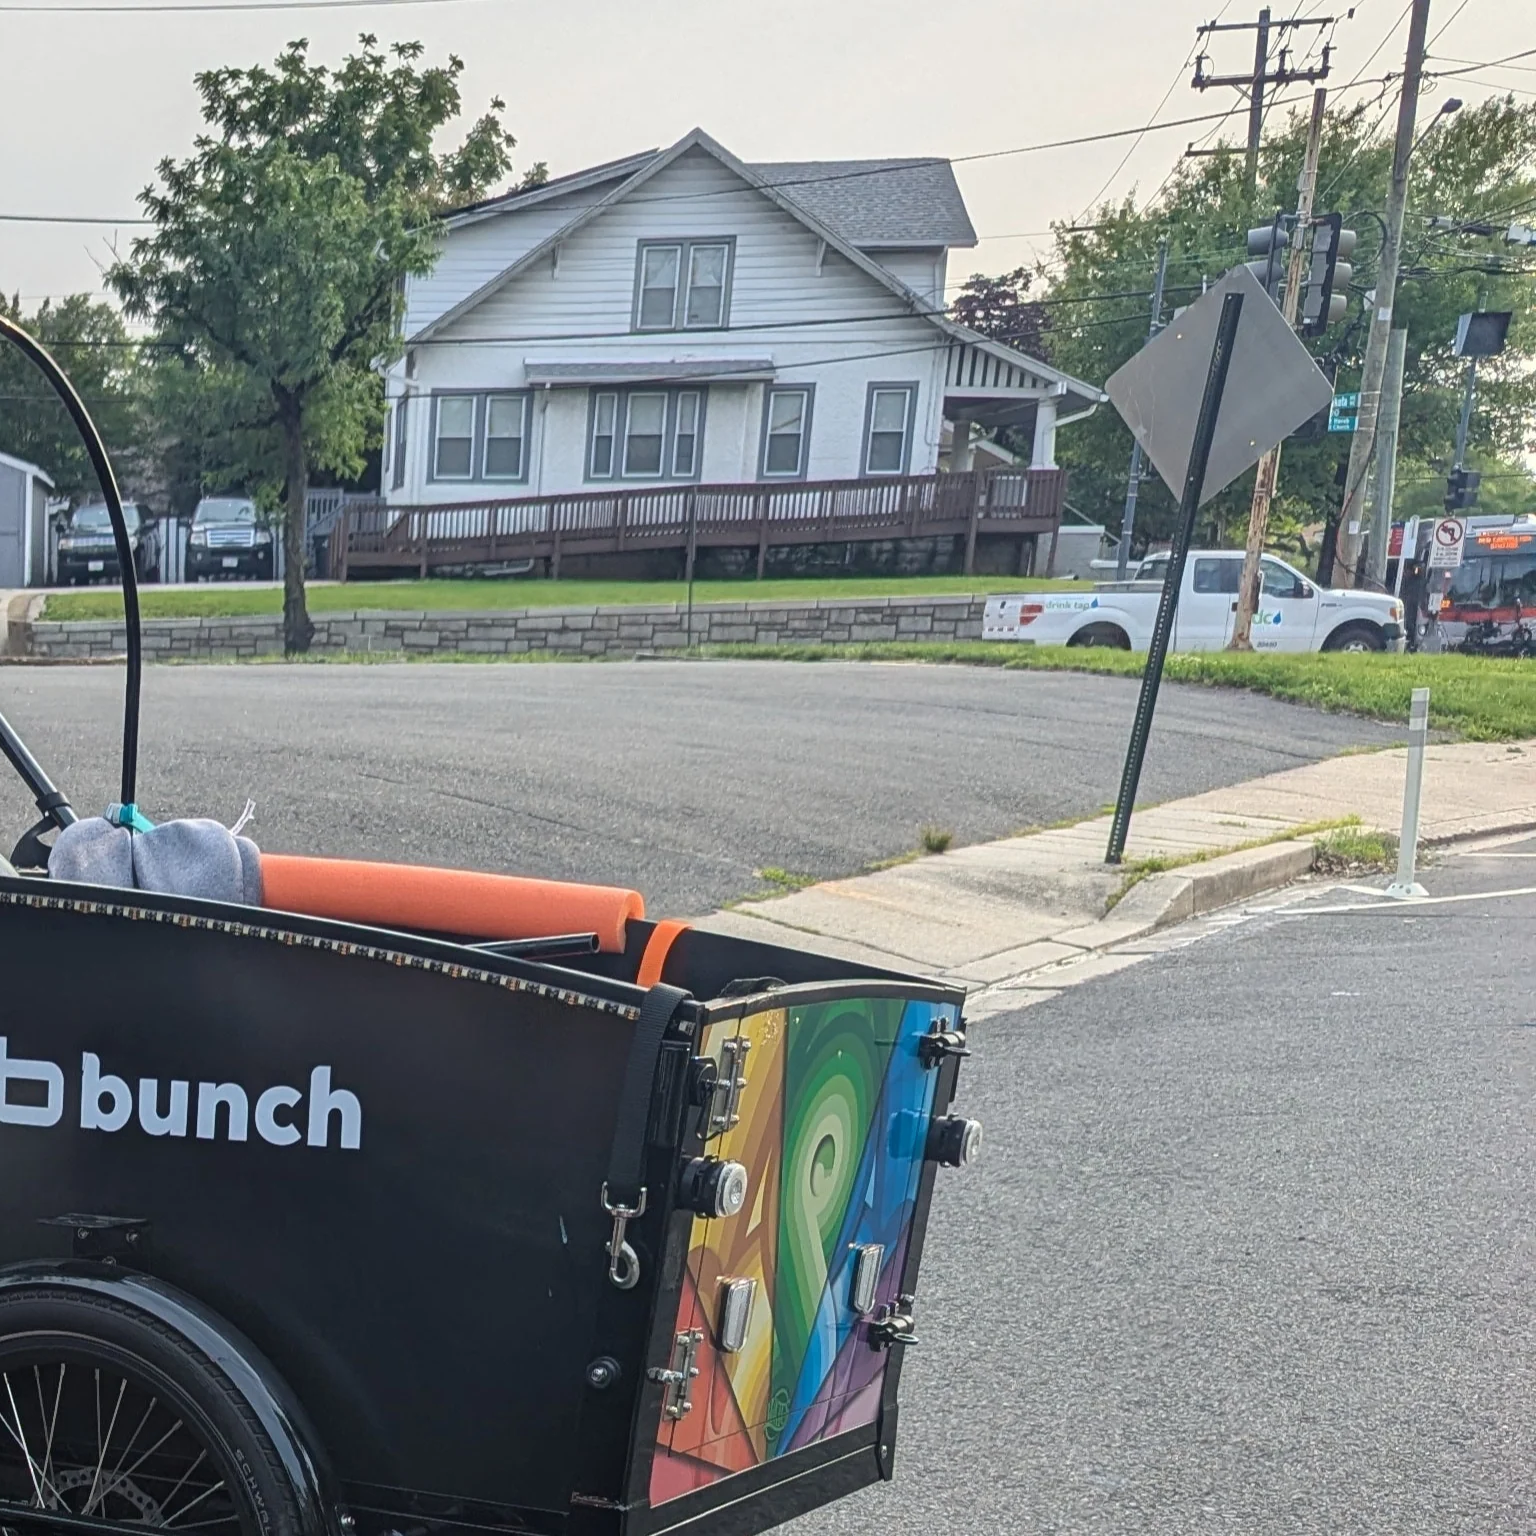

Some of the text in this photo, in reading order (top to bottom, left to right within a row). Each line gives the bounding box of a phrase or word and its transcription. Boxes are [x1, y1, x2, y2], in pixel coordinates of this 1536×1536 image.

[1046, 600, 1090, 611] drink tap
[80, 1051, 362, 1150] bunch
